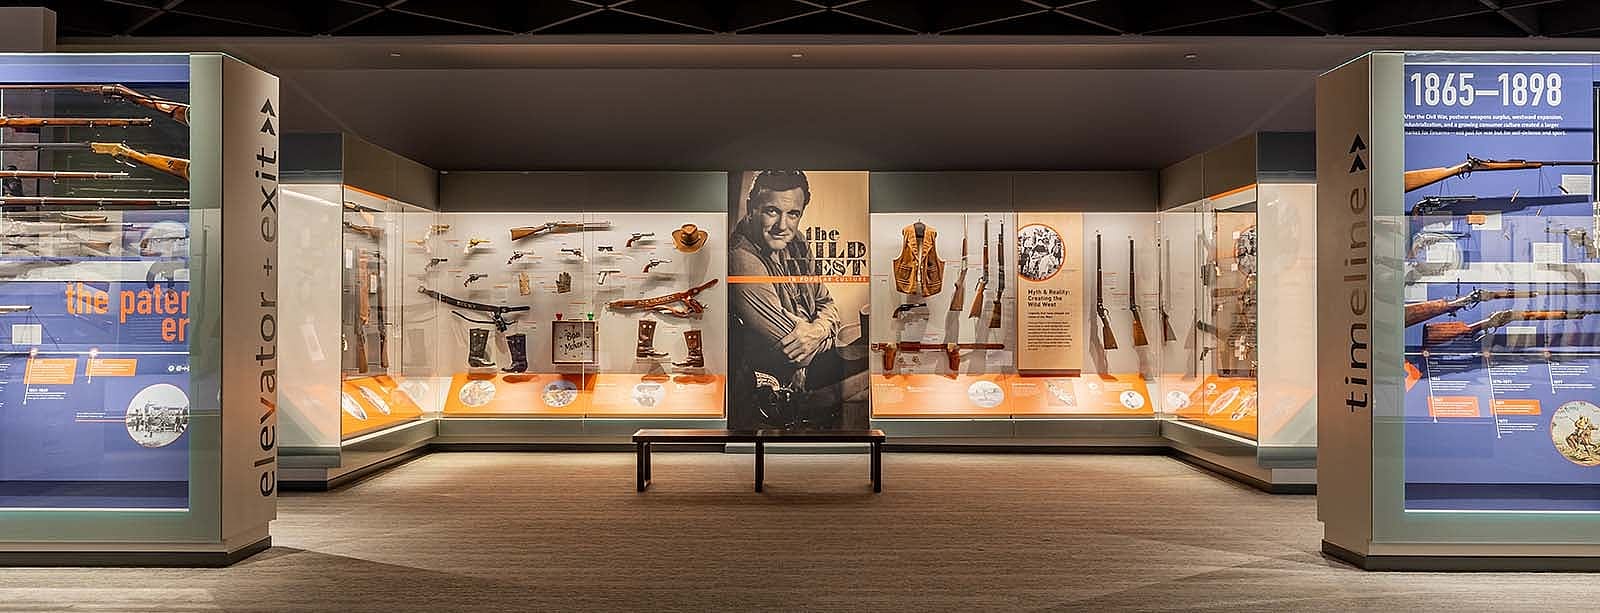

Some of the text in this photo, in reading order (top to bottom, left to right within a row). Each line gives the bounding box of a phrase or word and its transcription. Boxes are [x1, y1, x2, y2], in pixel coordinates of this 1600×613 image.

[1410, 72, 1562, 107] 1865–1898
[255, 147, 277, 243] exit
[805, 226, 840, 241] the
[65, 280, 110, 315] the
[1343, 187, 1368, 412] timeline
[254, 291, 276, 498] elevator
